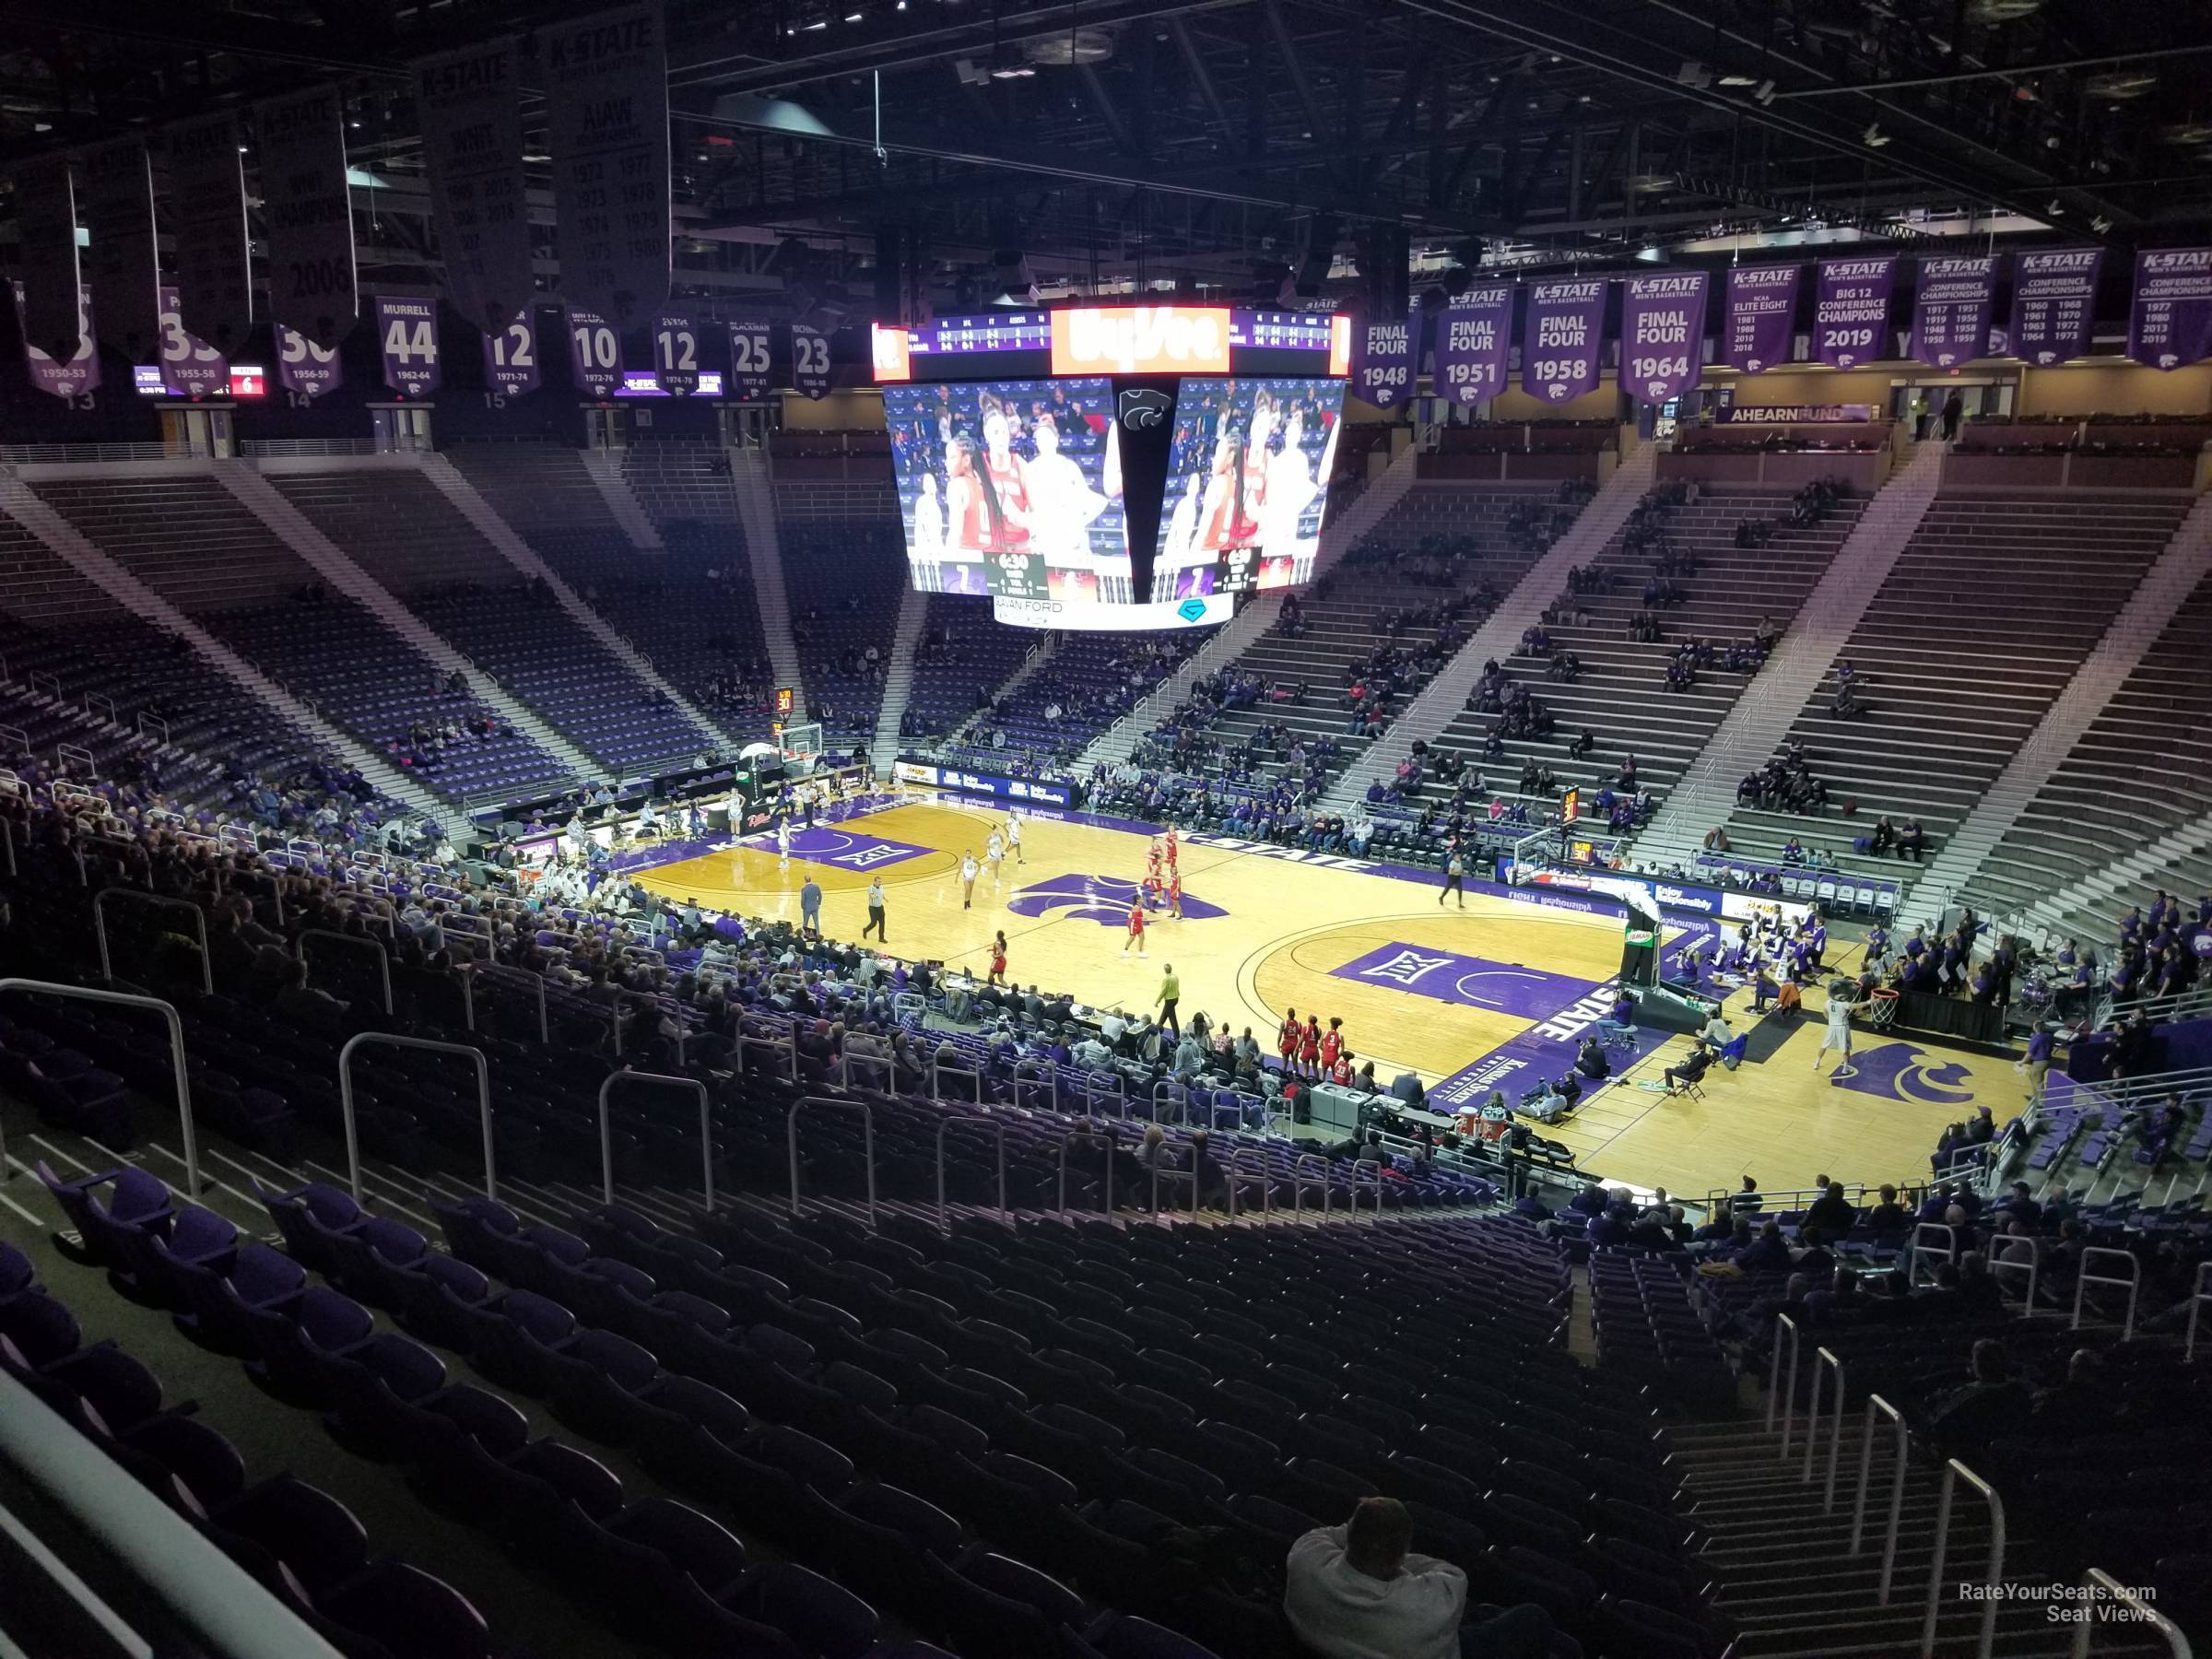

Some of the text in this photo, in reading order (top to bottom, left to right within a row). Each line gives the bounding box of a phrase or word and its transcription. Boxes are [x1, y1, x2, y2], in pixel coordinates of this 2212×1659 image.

[1924, 258, 1994, 273] K-STATE
[2023, 253, 2097, 269] K-STATE
[1734, 269, 1795, 284] K-STATE
[1825, 262, 1889, 276] K-STATE
[1630, 276, 1702, 294] K-STATE
[1930, 282, 1983, 292] CONFERENCE
[2029, 276, 2087, 288] CONFERENCE
[1534, 282, 1602, 300] K-STATE
[1836, 288, 1872, 300] BIG 12
[1920, 289, 1989, 300] CHAMPIONSHIPS
[2018, 285, 2092, 296] CHAMPIONSHIPS
[382, 304, 430, 315] MURRELL
[1734, 300, 1789, 312] ELITE EIGHT
[1819, 299, 1886, 311] CONFERENCE
[2025, 302, 2048, 311] 1960
[2147, 302, 2171, 312] 1977
[1540, 315, 1587, 332] FINAL
[1638, 311, 1688, 328] FINAL
[1818, 309, 1885, 323] CHAMPIONS
[2057, 312, 2080, 320] 1970
[2146, 313, 2170, 323] 1980
[1368, 325, 1408, 341] FINAL
[1450, 321, 1496, 336] FINAL
[2056, 321, 2079, 330] 1972
[2143, 324, 2168, 333] 2013
[385, 320, 437, 364] 44
[1449, 335, 1494, 351] FOUR
[1538, 332, 1585, 347] FOUR
[1636, 327, 1687, 344] FOUR
[1824, 329, 1873, 347] 2019
[2022, 332, 2078, 341] 1964 1973
[2141, 335, 2167, 344] 2019
[493, 324, 534, 366] 12
[575, 327, 618, 369] 10
[657, 332, 697, 371] 12
[1367, 341, 1407, 356] FOUR
[733, 335, 771, 372] 25
[795, 337, 830, 374] 23
[41, 369, 87, 379] 1950-53
[175, 369, 216, 379] 1955-58
[293, 370, 329, 379] 1956-59
[1447, 364, 1496, 383] 1951
[1534, 359, 1587, 381] 1958
[1632, 357, 1689, 378] 1964
[396, 371, 430, 380] 1962-64
[497, 372, 528, 382] 1971-74
[585, 373, 614, 382] 1972-76
[1363, 367, 1407, 386] 1948
[241, 376, 253, 393] 6
[484, 392, 506, 409] 15
[1731, 408, 1798, 422] AHEARN
